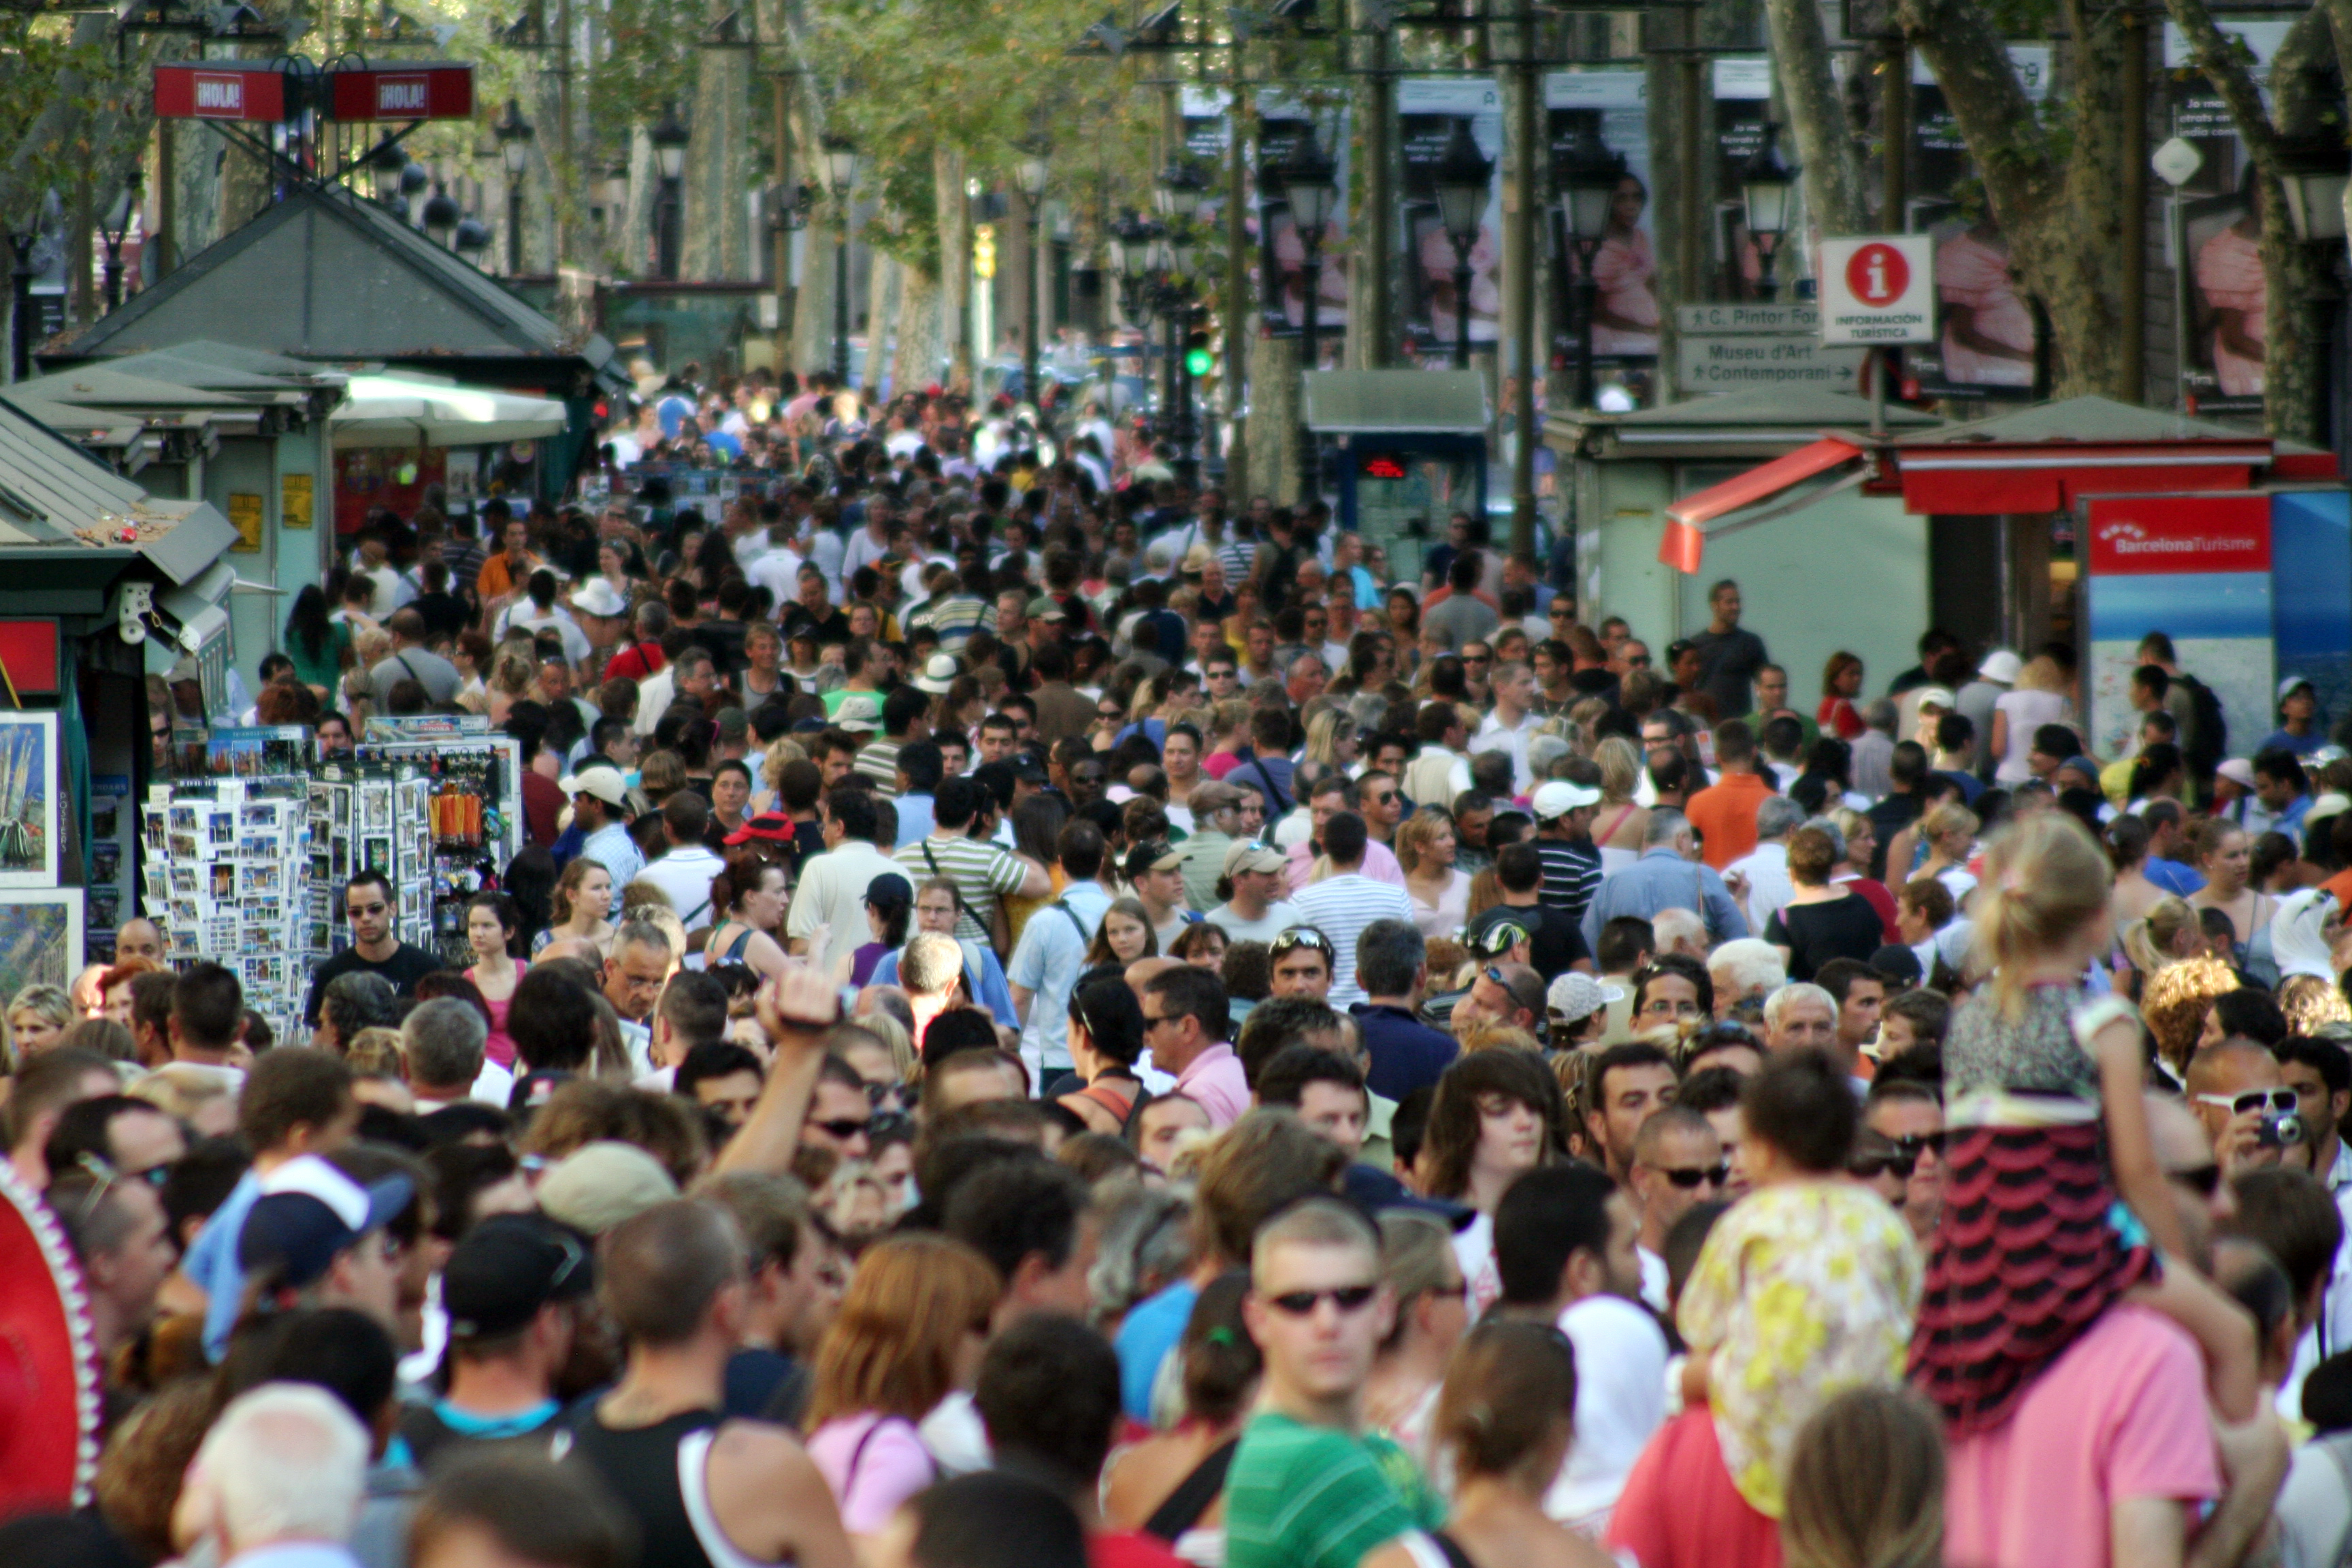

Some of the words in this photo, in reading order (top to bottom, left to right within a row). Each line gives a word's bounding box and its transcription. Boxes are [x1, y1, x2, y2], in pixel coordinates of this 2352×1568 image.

[197, 82, 241, 108] ¡HOLA!
[380, 84, 425, 110] ¡HOLA!
[1709, 309, 1727, 324] C.
[1733, 308, 1784, 325] Pintor
[1835, 313, 1923, 326] INFORMACIÓN
[1850, 327, 1908, 339] TURÍSTICA
[1709, 344, 1765, 360] Museu
[1771, 344, 1812, 360] d'Art
[1709, 365, 1830, 382] Contemporani
[59, 792, 67, 853] POSTERS
